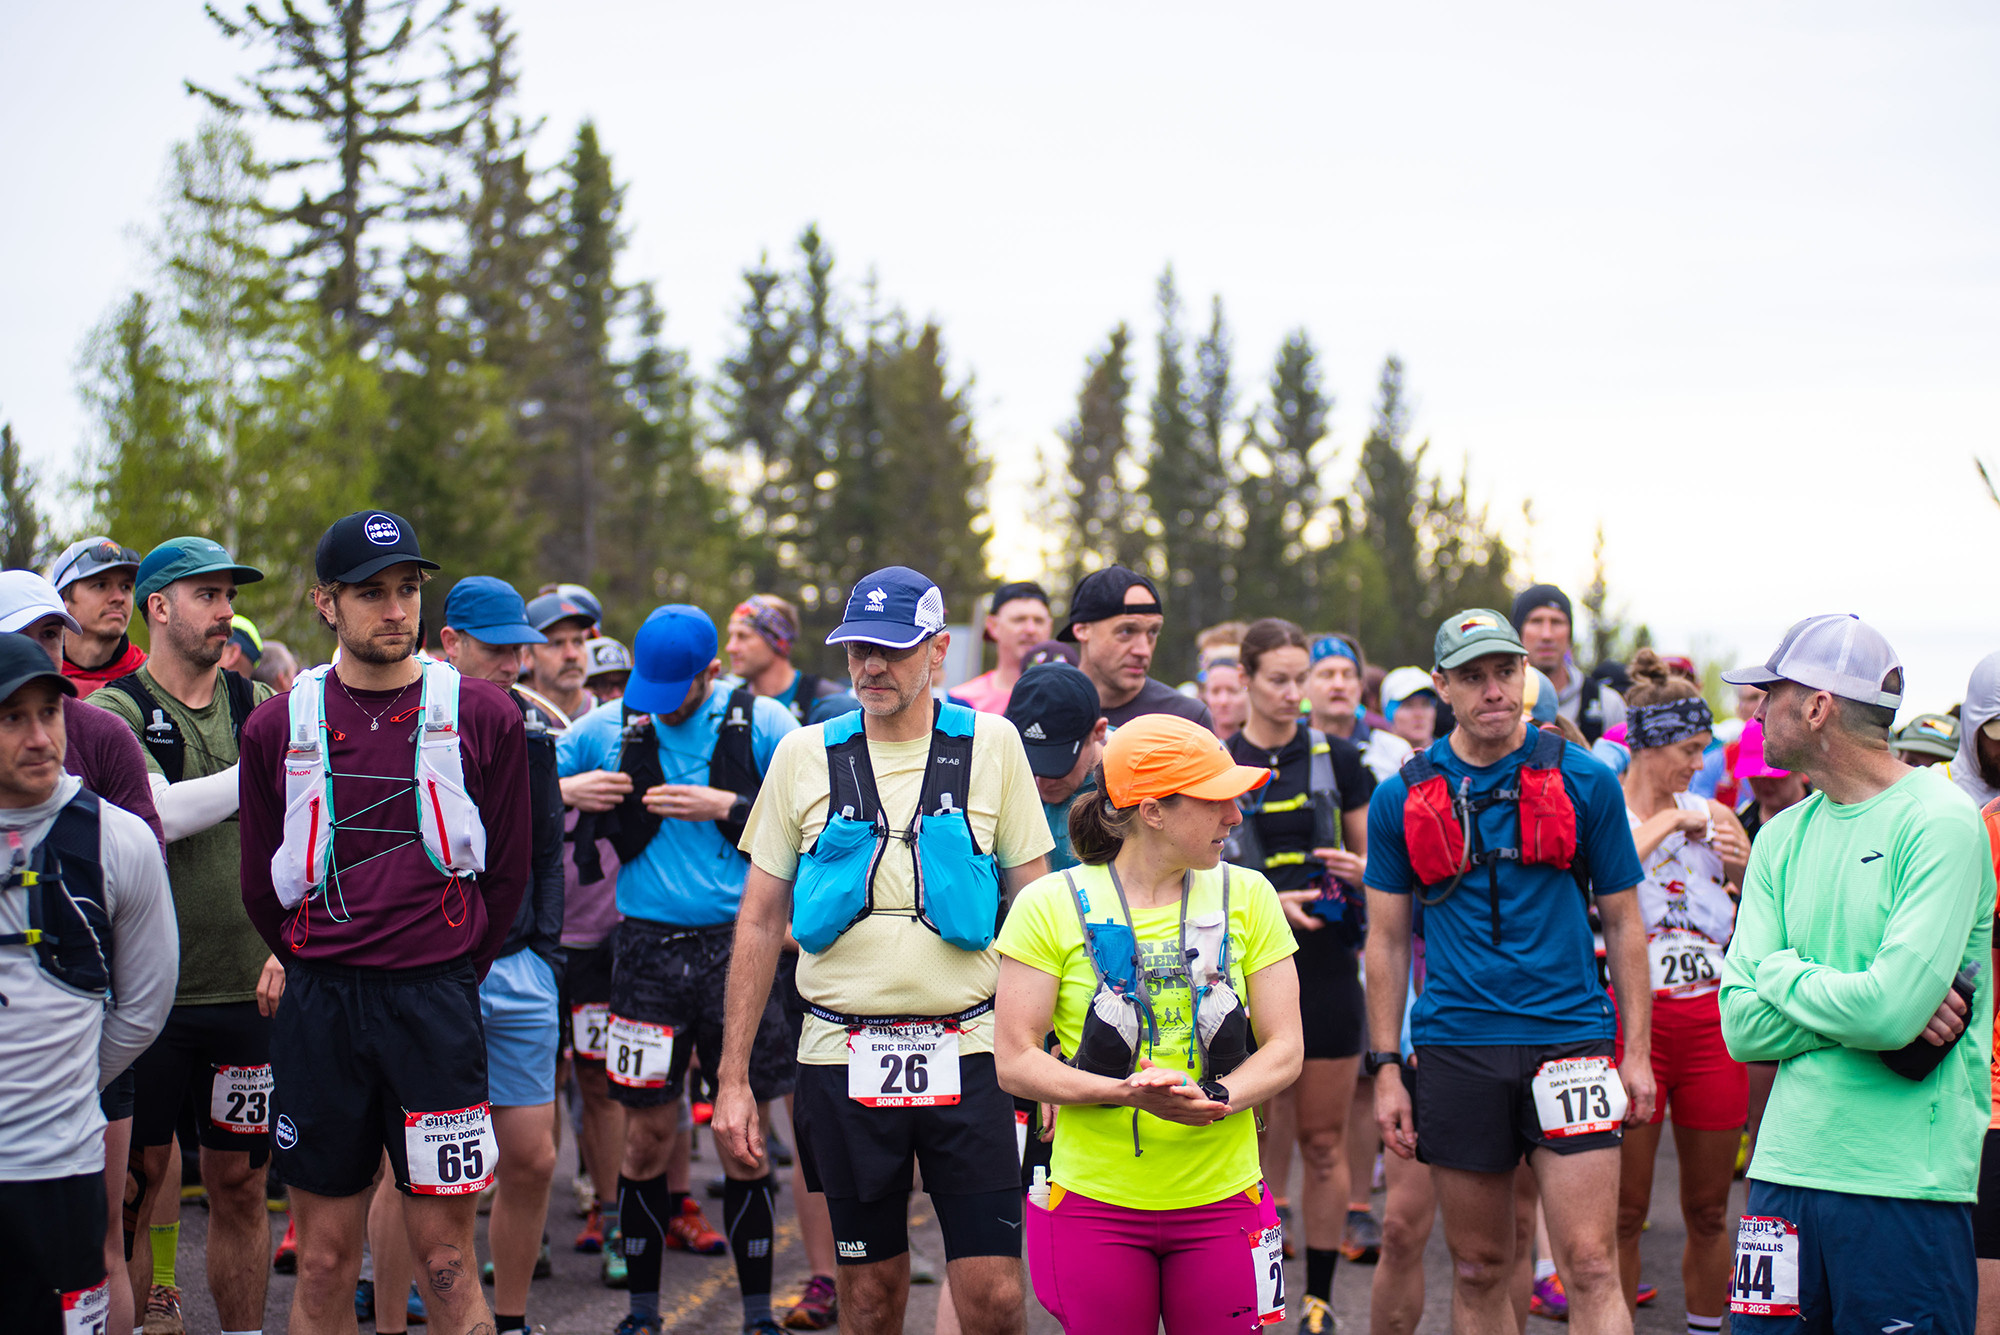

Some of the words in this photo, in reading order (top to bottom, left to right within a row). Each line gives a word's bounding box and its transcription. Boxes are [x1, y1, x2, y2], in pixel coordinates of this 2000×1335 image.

[368, 523, 393, 531] ROCK
[370, 530, 397, 539] ROOM
[865, 604, 884, 613] rabbit
[1023, 731, 1047, 739] adidas
[1661, 953, 1714, 985] 293
[872, 1043, 895, 1052] ERIC
[897, 1042, 937, 1052] BRANDT
[617, 1045, 643, 1077] 81
[880, 1053, 929, 1094] 26
[1549, 1080, 1568, 1088] DAN
[876, 1098, 904, 1107] 50KM
[911, 1096, 936, 1106] 2025
[1556, 1084, 1611, 1124] 173
[424, 1134, 456, 1142] STEVE
[437, 1139, 484, 1183] 65
[435, 1186, 462, 1194] 50KM
[469, 1181, 486, 1191] 2025
[837, 1240, 865, 1251] UTMB
[1748, 1304, 1771, 1314] 2025
